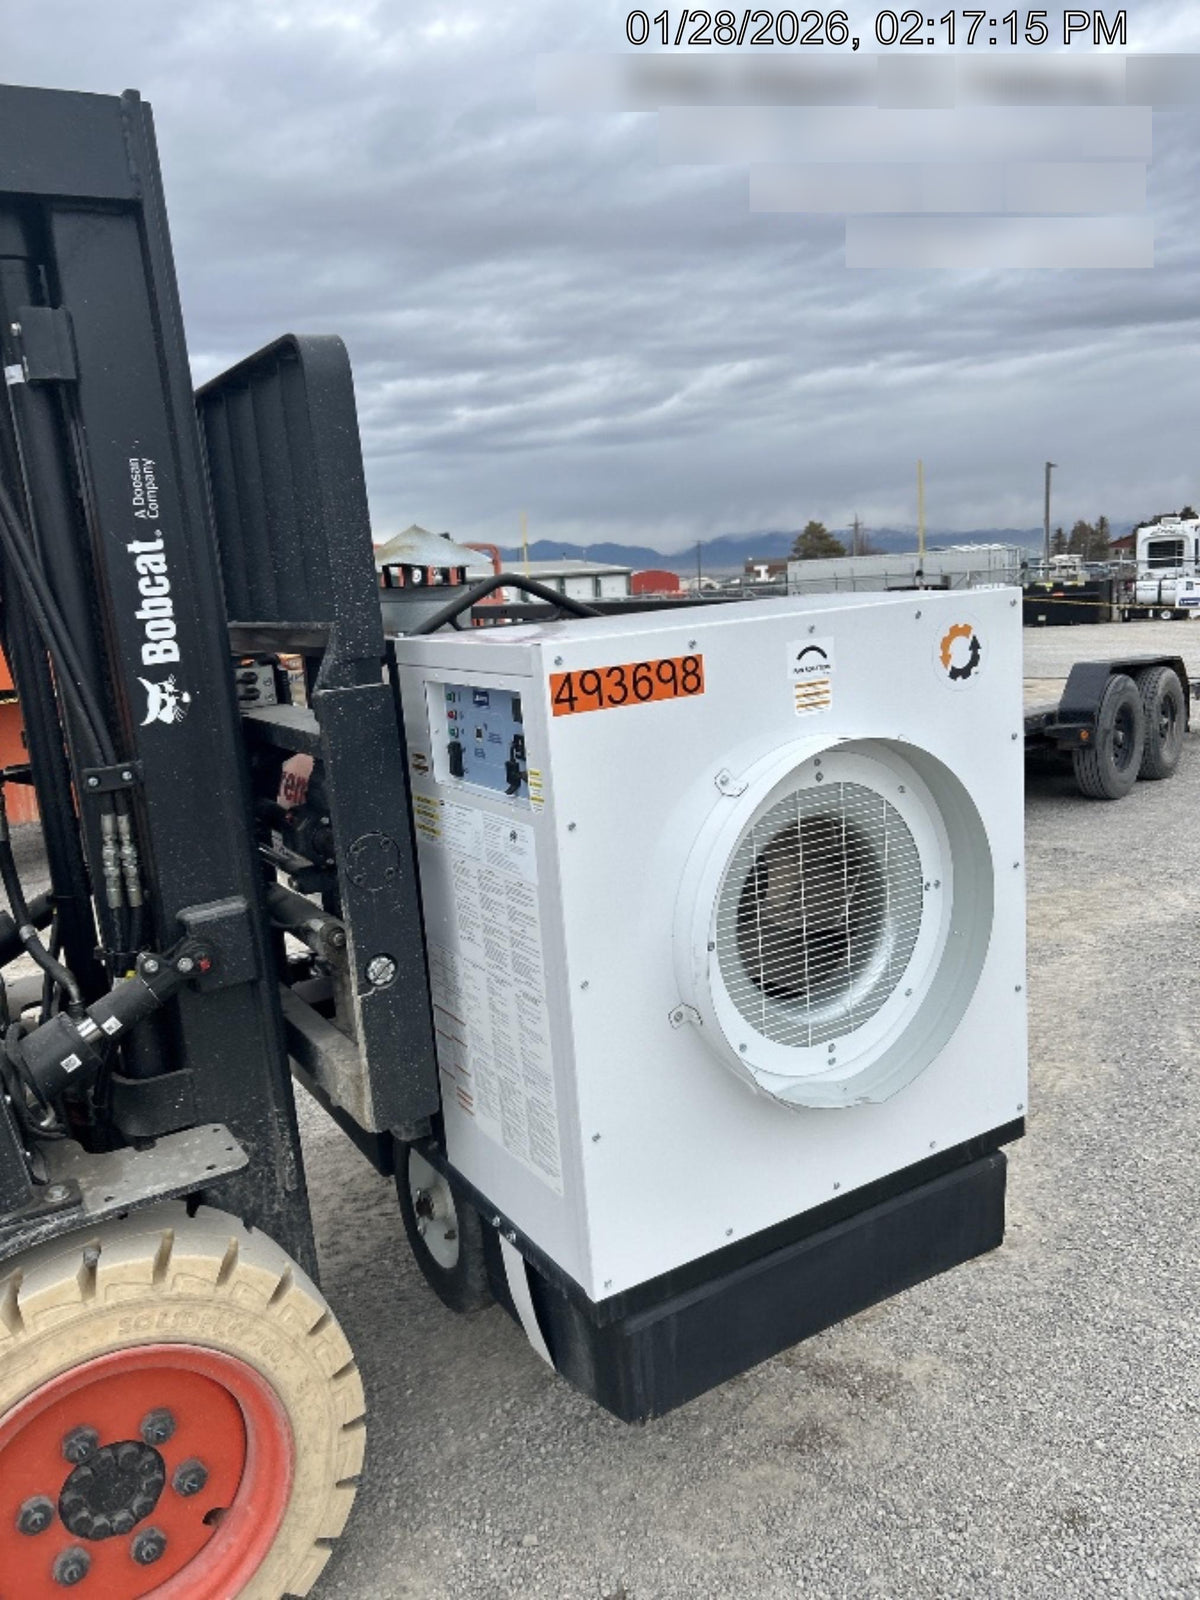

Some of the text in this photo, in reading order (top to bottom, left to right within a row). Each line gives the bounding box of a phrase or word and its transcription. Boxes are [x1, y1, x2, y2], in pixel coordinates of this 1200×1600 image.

[129, 457, 148, 520] A Doosan
[141, 457, 160, 519] Company
[554, 655, 702, 711] 493698
